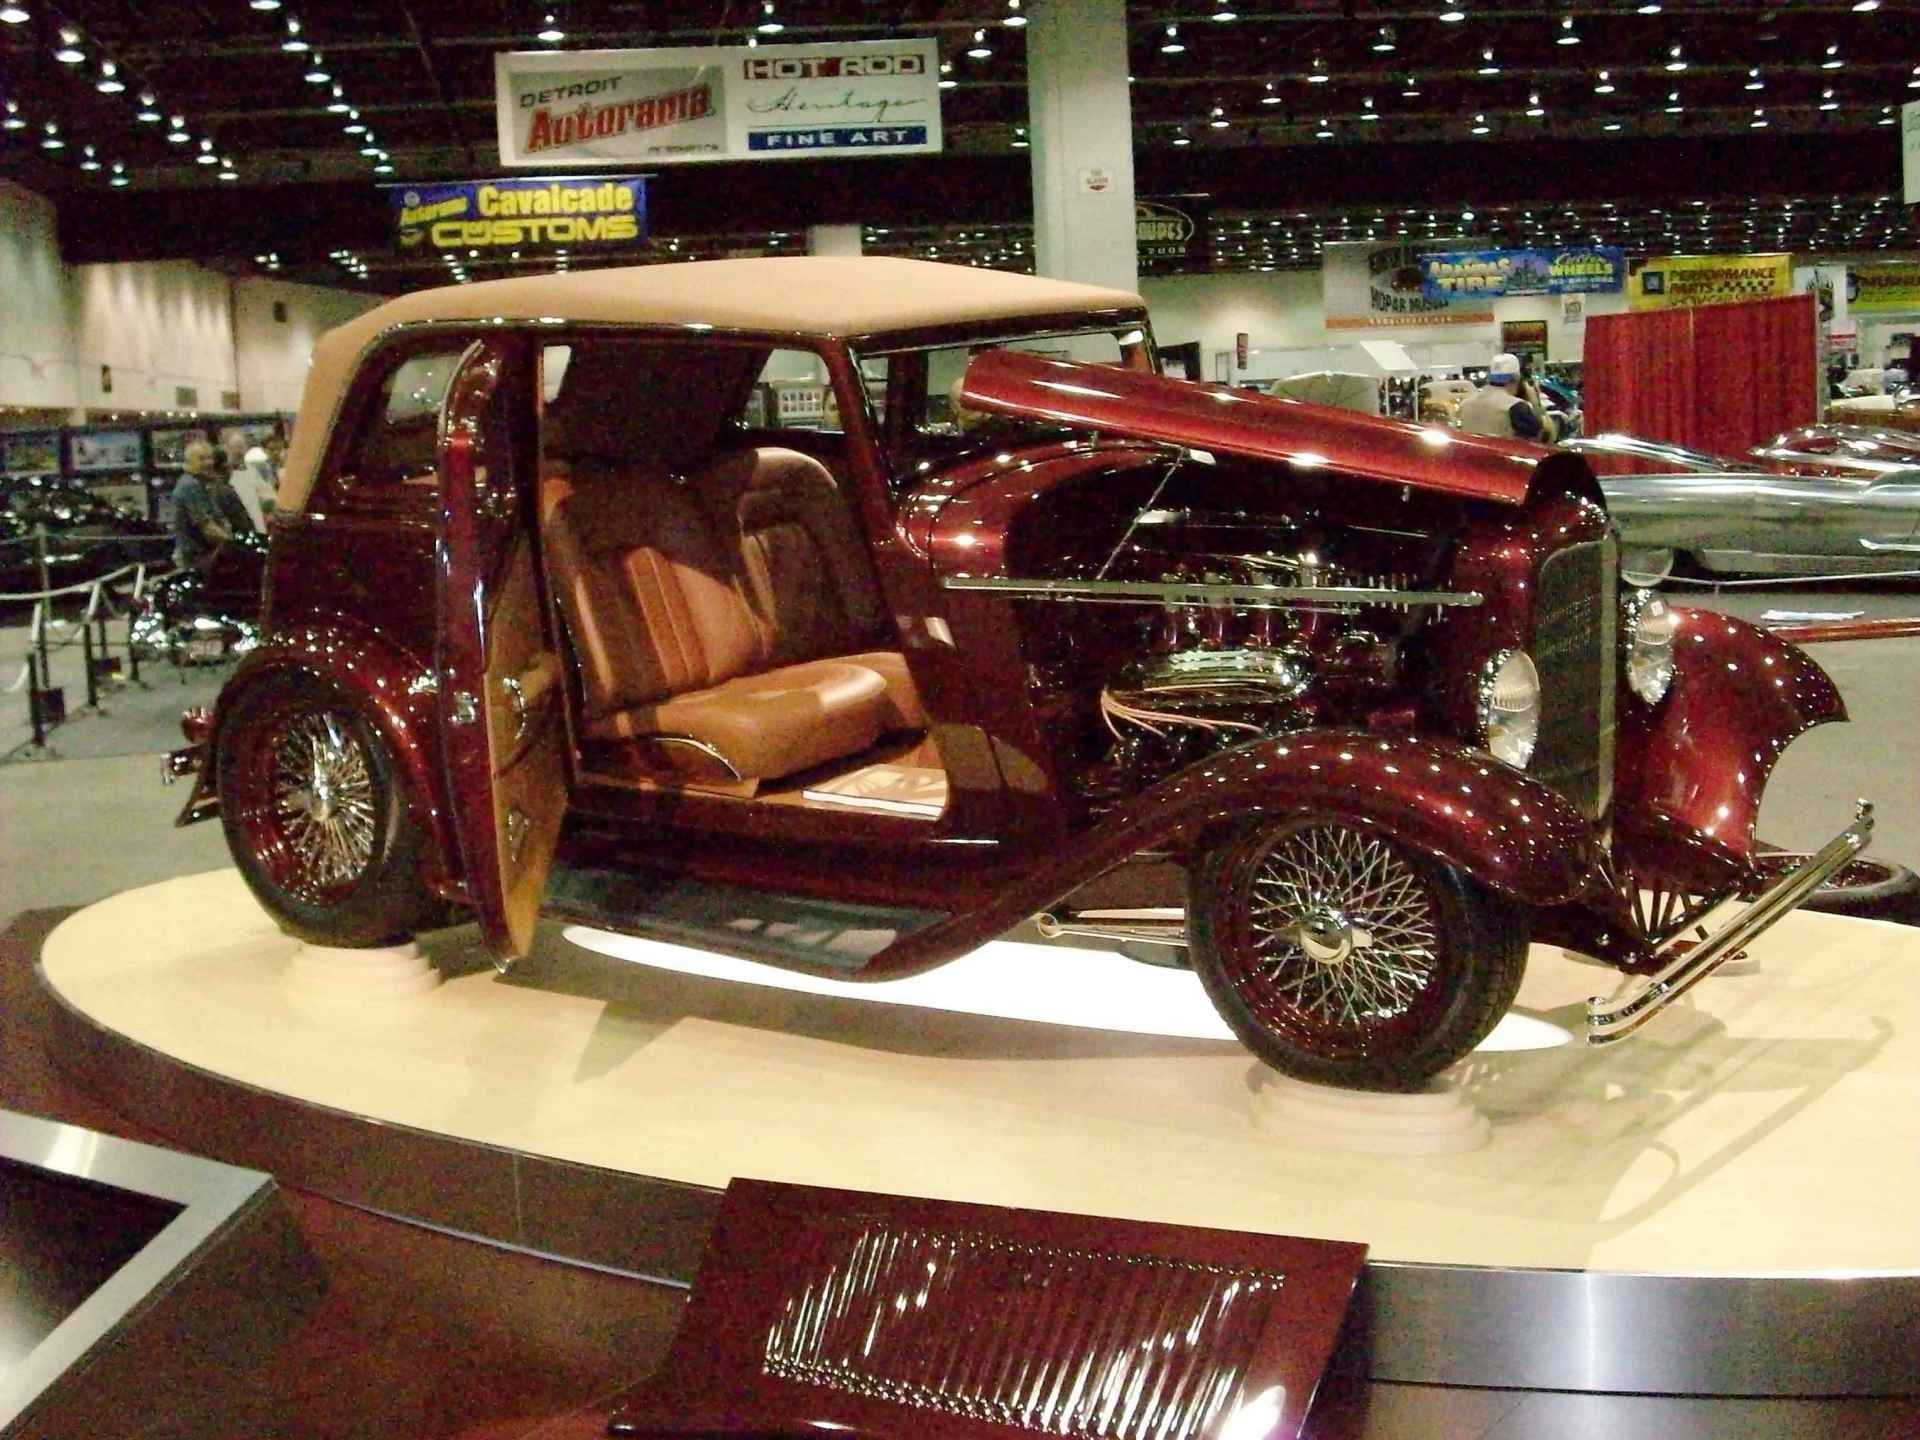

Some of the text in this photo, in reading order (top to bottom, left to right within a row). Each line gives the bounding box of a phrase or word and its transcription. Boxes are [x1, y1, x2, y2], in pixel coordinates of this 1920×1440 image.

[749, 54, 922, 80] HOT ROD
[520, 76, 622, 108] DETROIT
[748, 86, 928, 123] Heritage
[525, 81, 717, 154] Autorama
[767, 129, 909, 147] FINE ART
[477, 181, 635, 217] Cavalcade
[431, 214, 639, 248] CUSTOMS
[1437, 275, 1505, 291] TIRE
[1669, 266, 1776, 282] PERFORMANCE
[1669, 282, 1714, 295] PARTS
